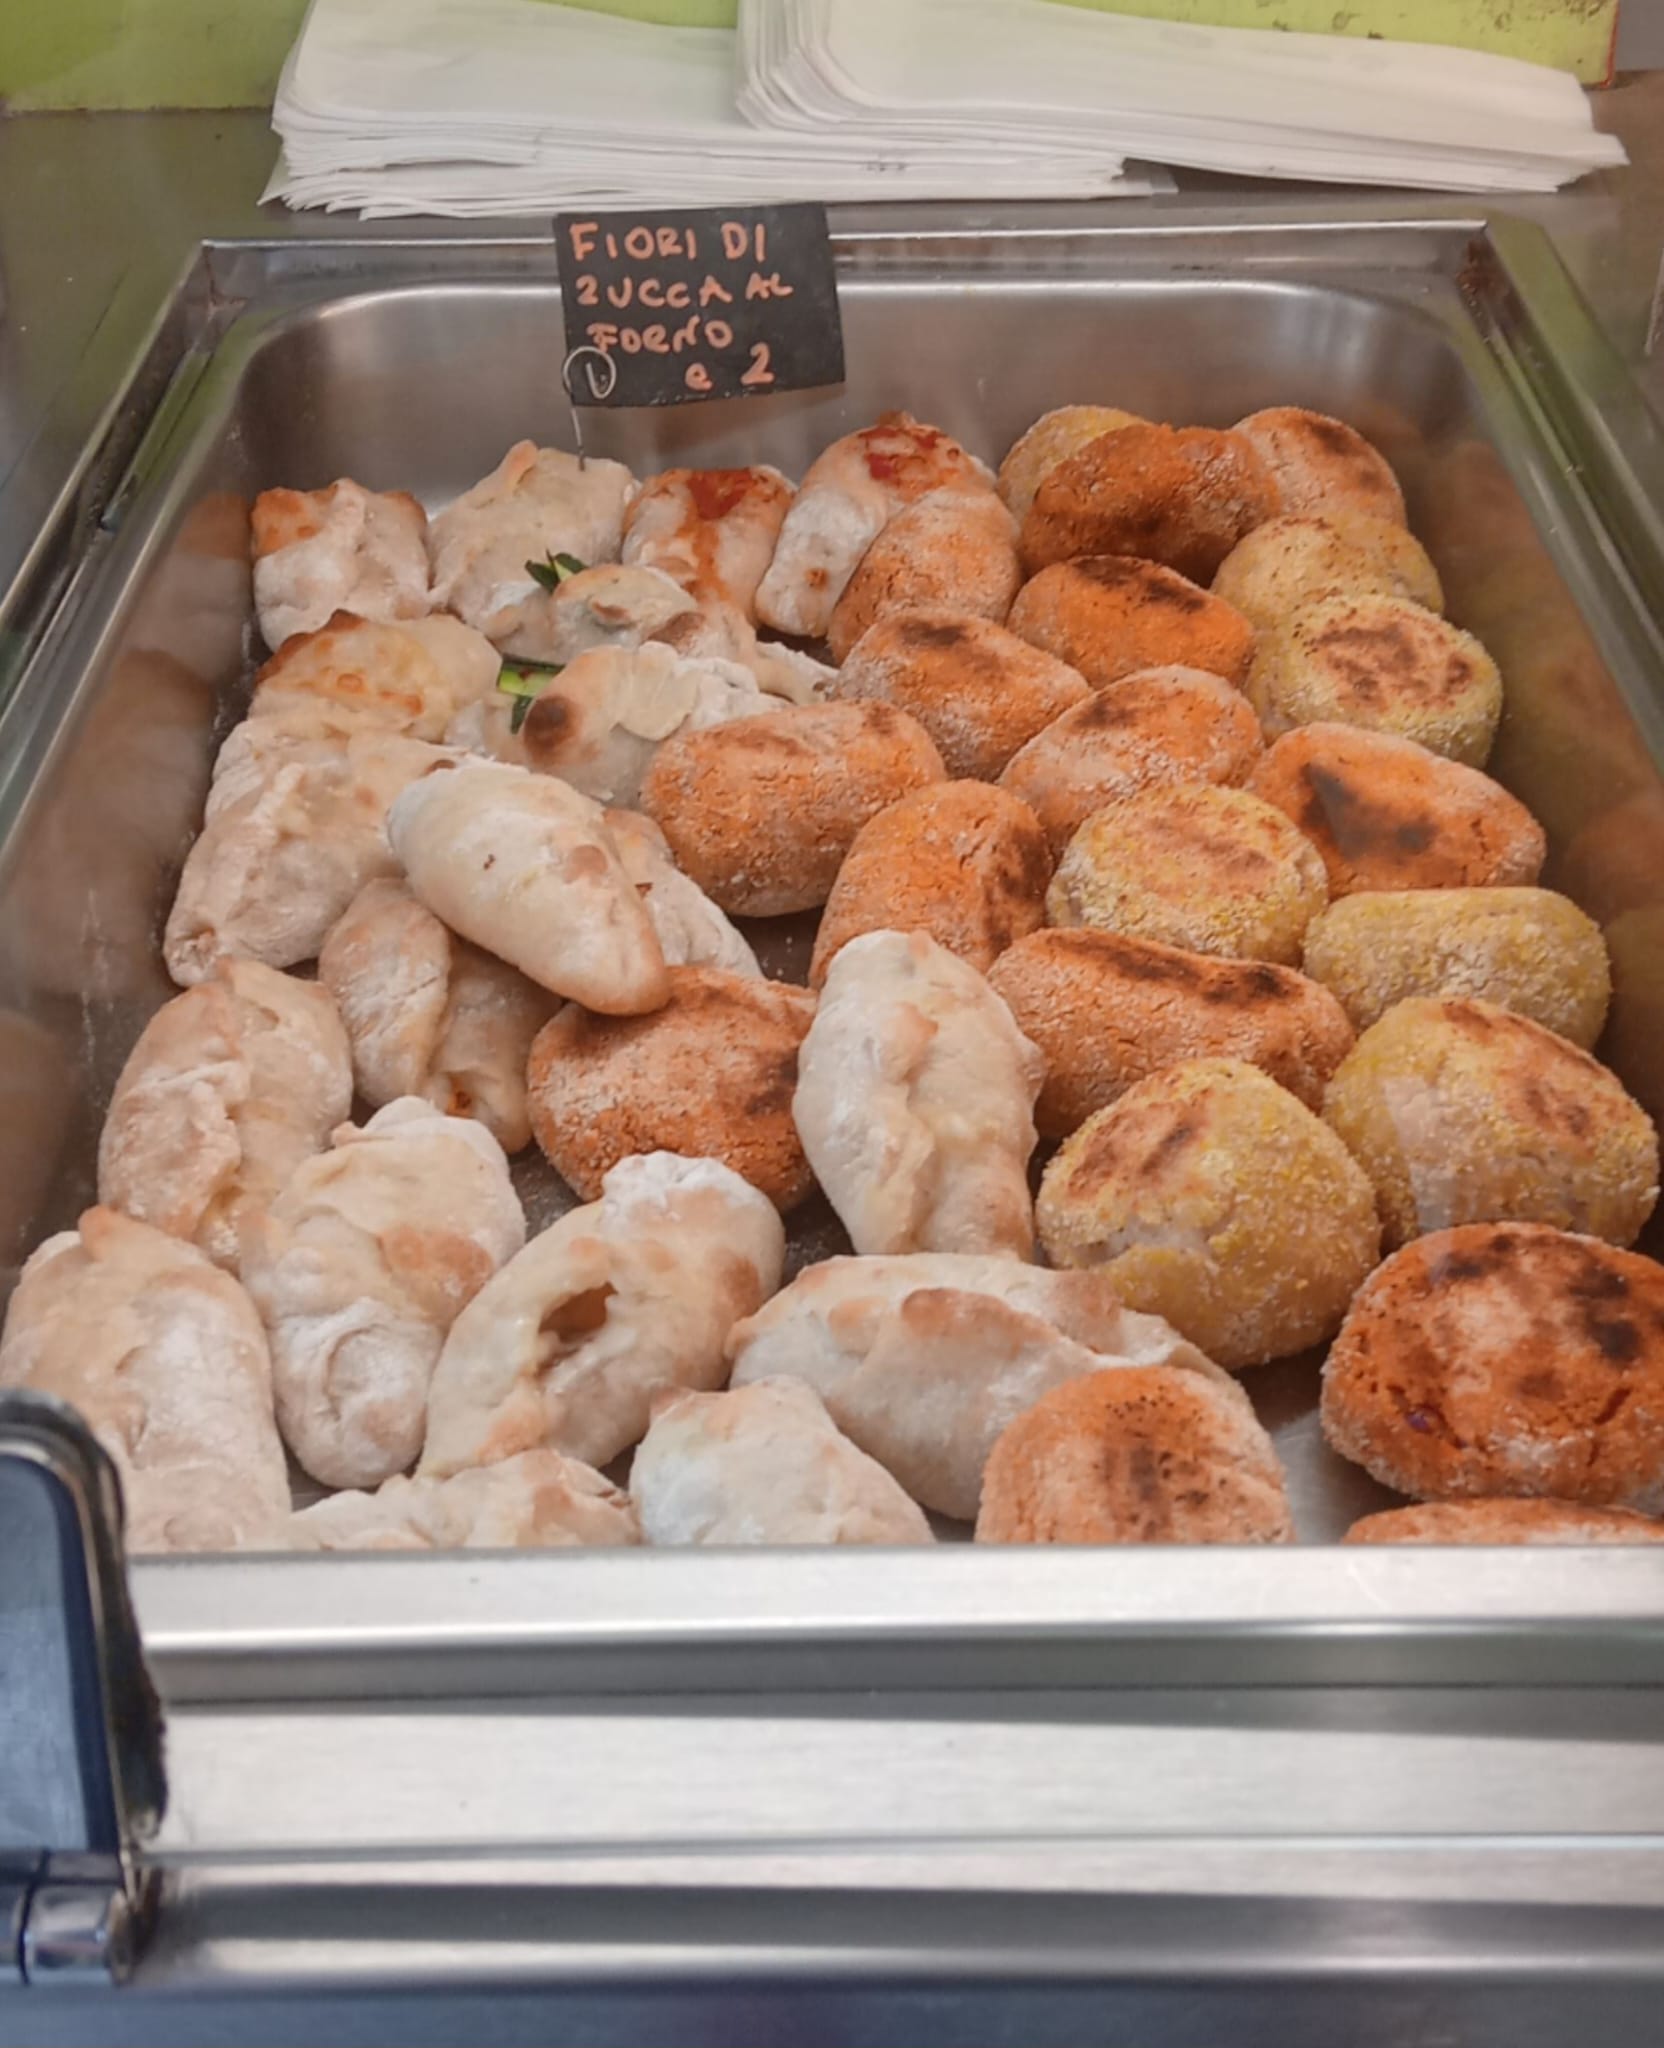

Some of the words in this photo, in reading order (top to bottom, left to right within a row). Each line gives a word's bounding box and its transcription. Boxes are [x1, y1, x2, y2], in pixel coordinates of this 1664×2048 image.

[569, 221, 697, 262] FIORI
[720, 221, 766, 263] DI
[740, 342, 775, 385] 2
